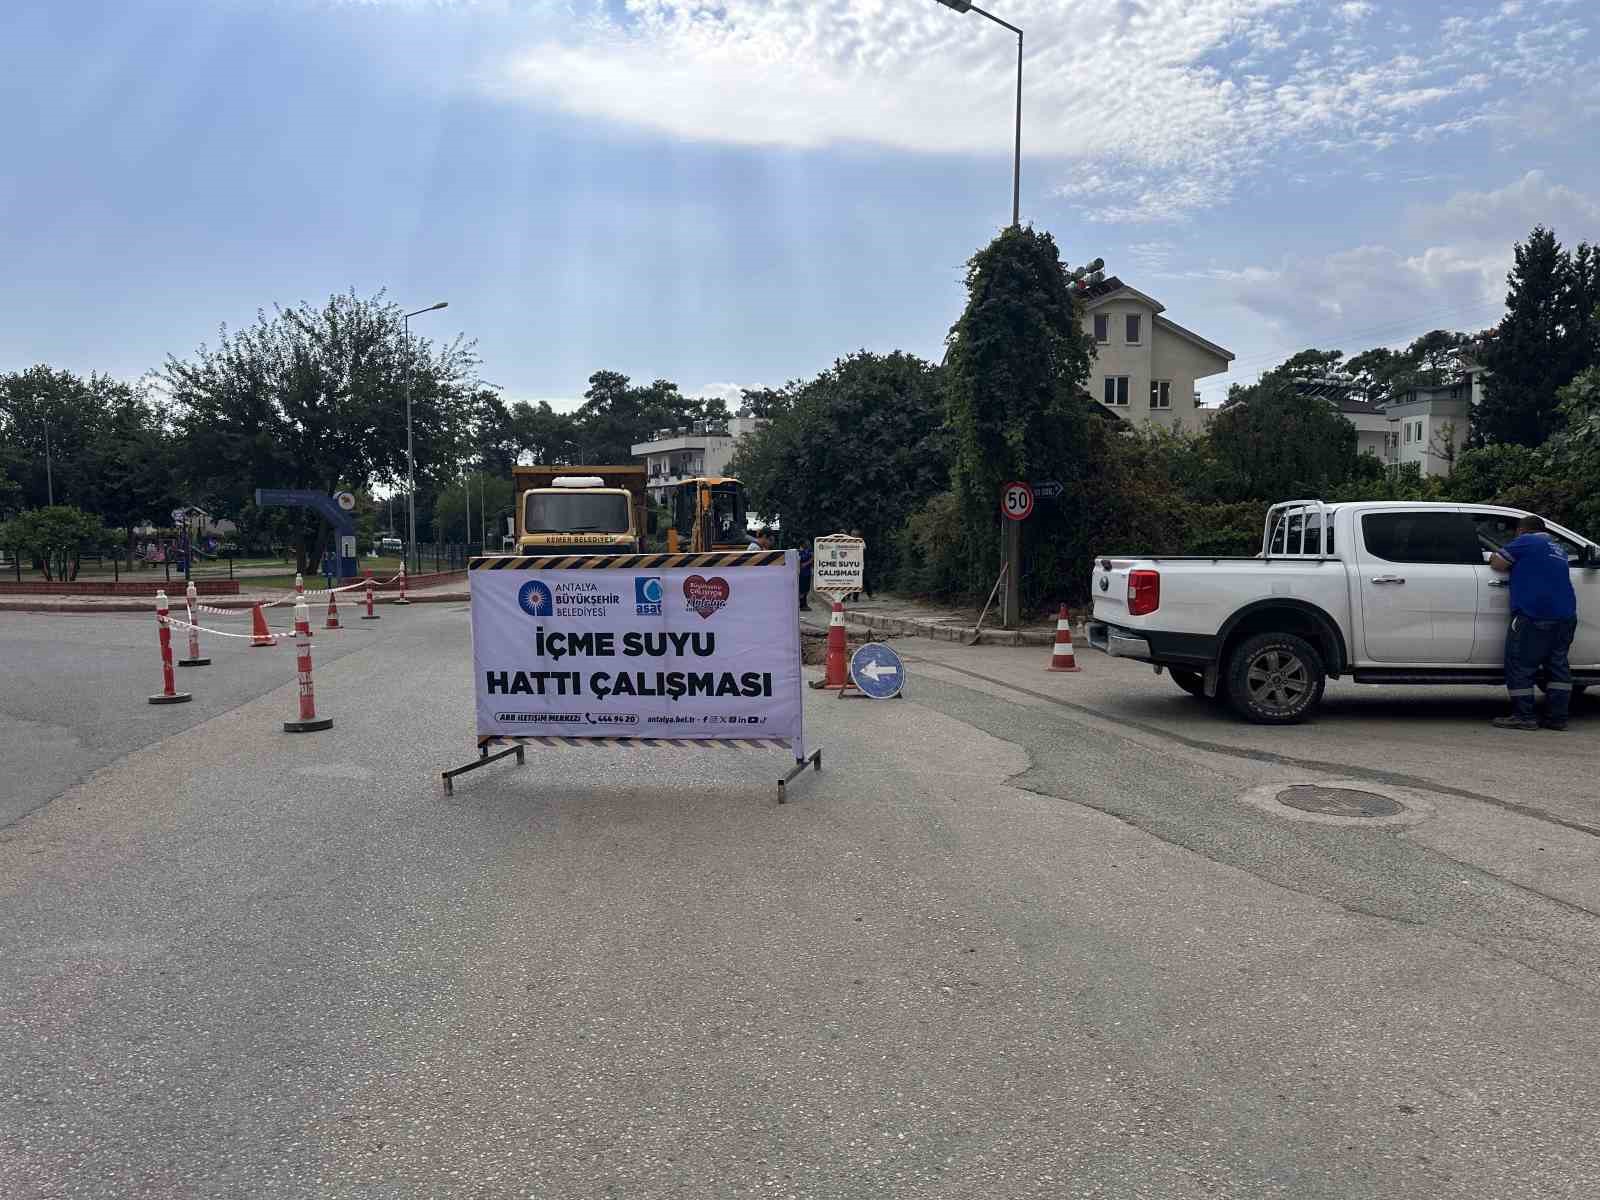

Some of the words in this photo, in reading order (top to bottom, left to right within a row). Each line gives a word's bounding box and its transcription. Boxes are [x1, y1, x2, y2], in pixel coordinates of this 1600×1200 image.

[1007, 492, 1029, 510] 50
[838, 560, 860, 568] SUYU
[555, 583, 599, 592] ANTALYA
[555, 594, 620, 606] BÜYÜKŞEHİR
[556, 606, 607, 617] BELEDİYESİ
[536, 626, 615, 660] İÇME
[622, 632, 716, 657] SUYU
[486, 671, 581, 695] HATTI
[589, 671, 773, 701] ÇALIŞMASI
